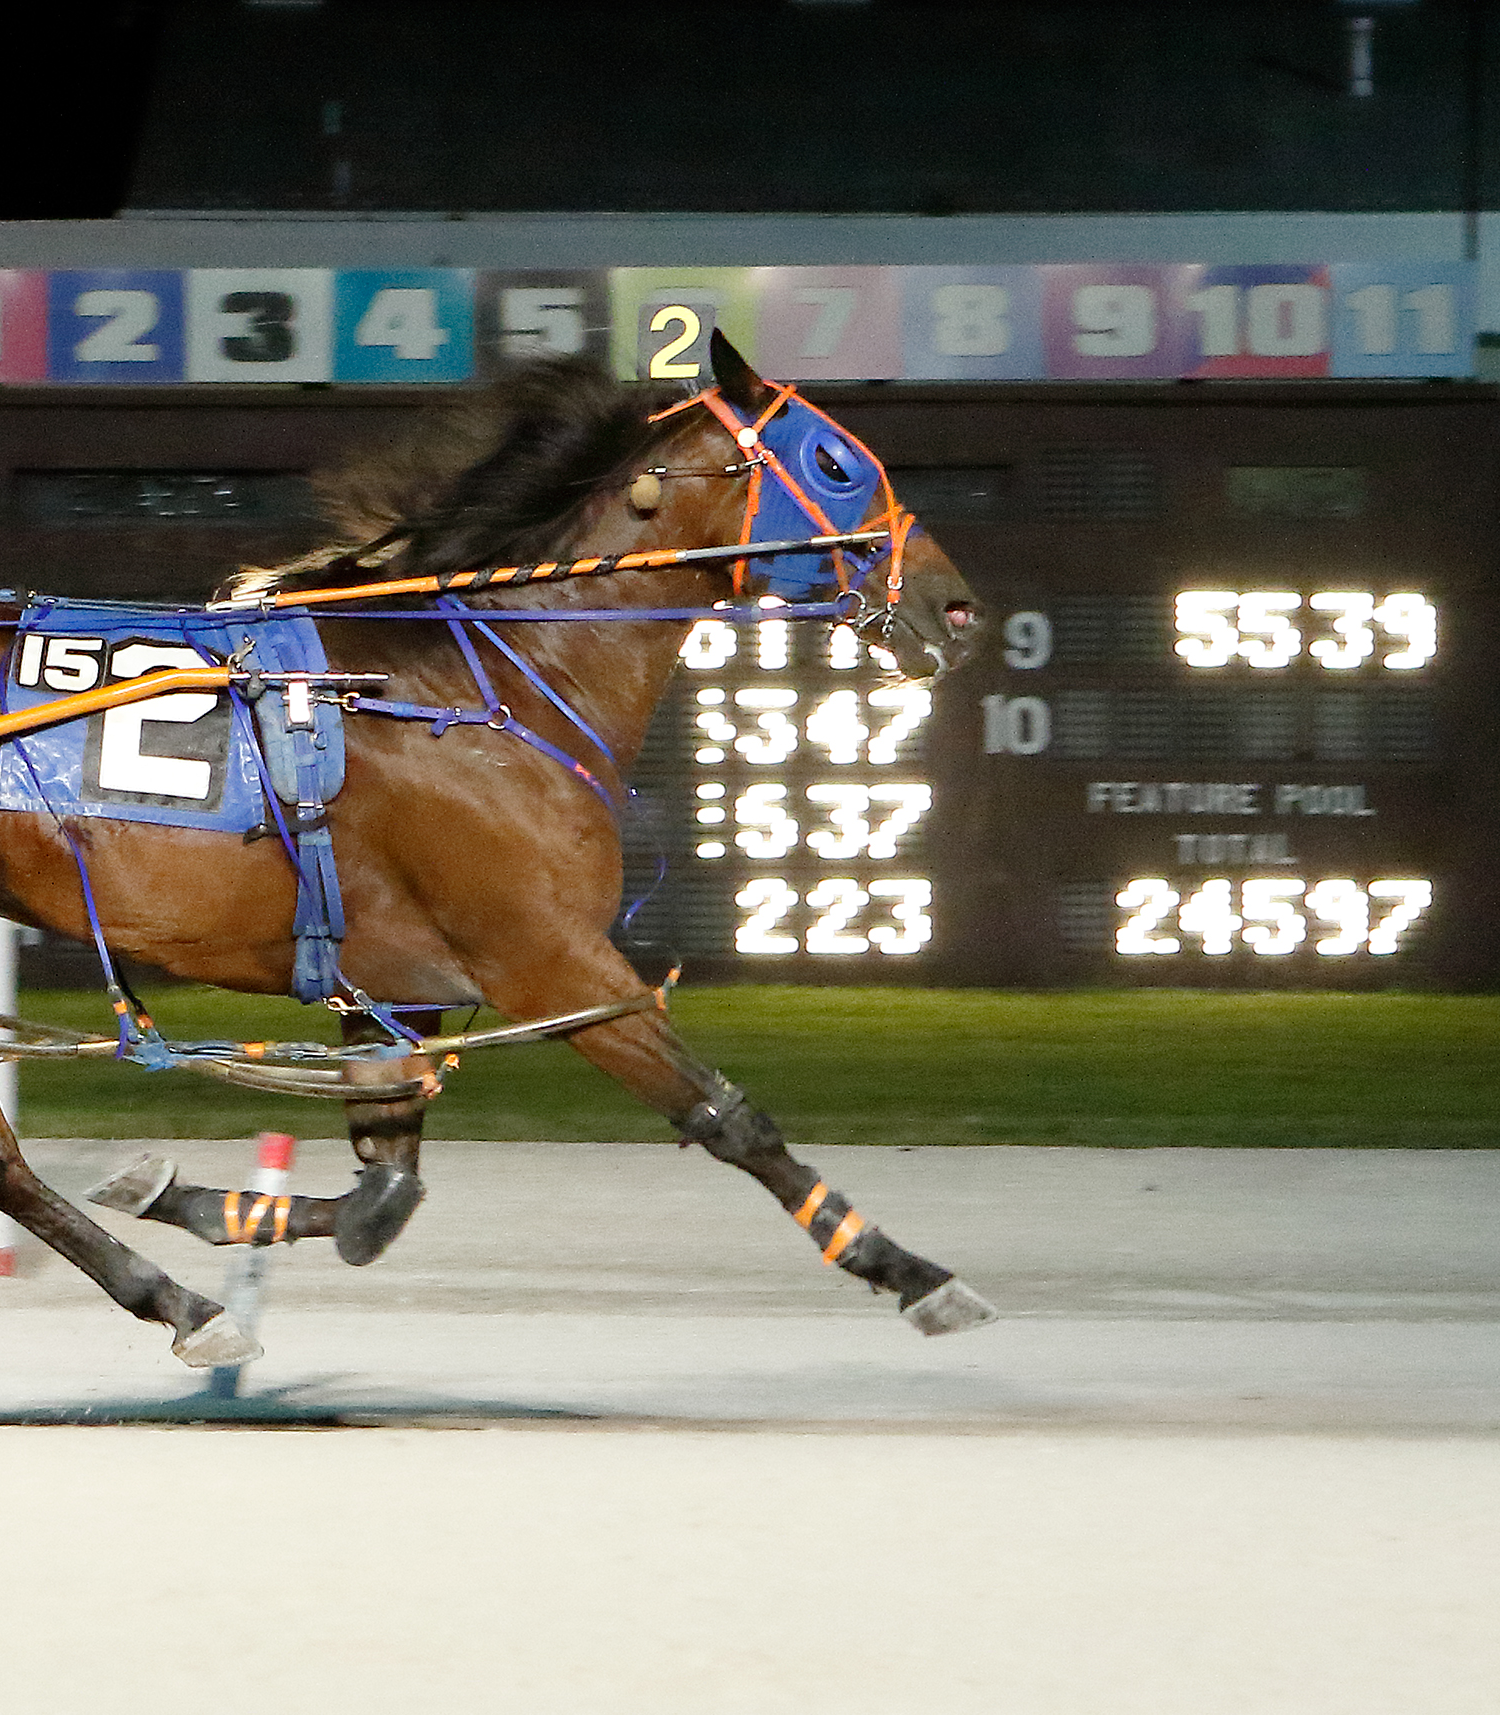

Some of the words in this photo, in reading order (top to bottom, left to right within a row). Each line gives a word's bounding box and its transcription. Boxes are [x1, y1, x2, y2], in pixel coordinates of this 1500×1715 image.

[73, 289, 162, 363] 2
[219, 290, 297, 363] 3
[355, 288, 450, 361] 4
[501, 286, 586, 352] 5
[784, 286, 862, 360] 7
[932, 284, 1011, 356] 8
[1069, 284, 1158, 357] 9
[1184, 284, 1328, 357] 10
[1342, 283, 1459, 355] 11
[649, 304, 701, 380] 2
[18, 633, 106, 693] 15
[1002, 610, 1052, 670] 9
[1174, 590, 1437, 670] 5539
[98, 642, 220, 801] 2
[981, 693, 1053, 756] 10
[1086, 781, 1263, 815] FEATURE
[1172, 833, 1300, 866] TOTAL
[734, 877, 933, 954] 223
[1114, 877, 1434, 956] 24597
